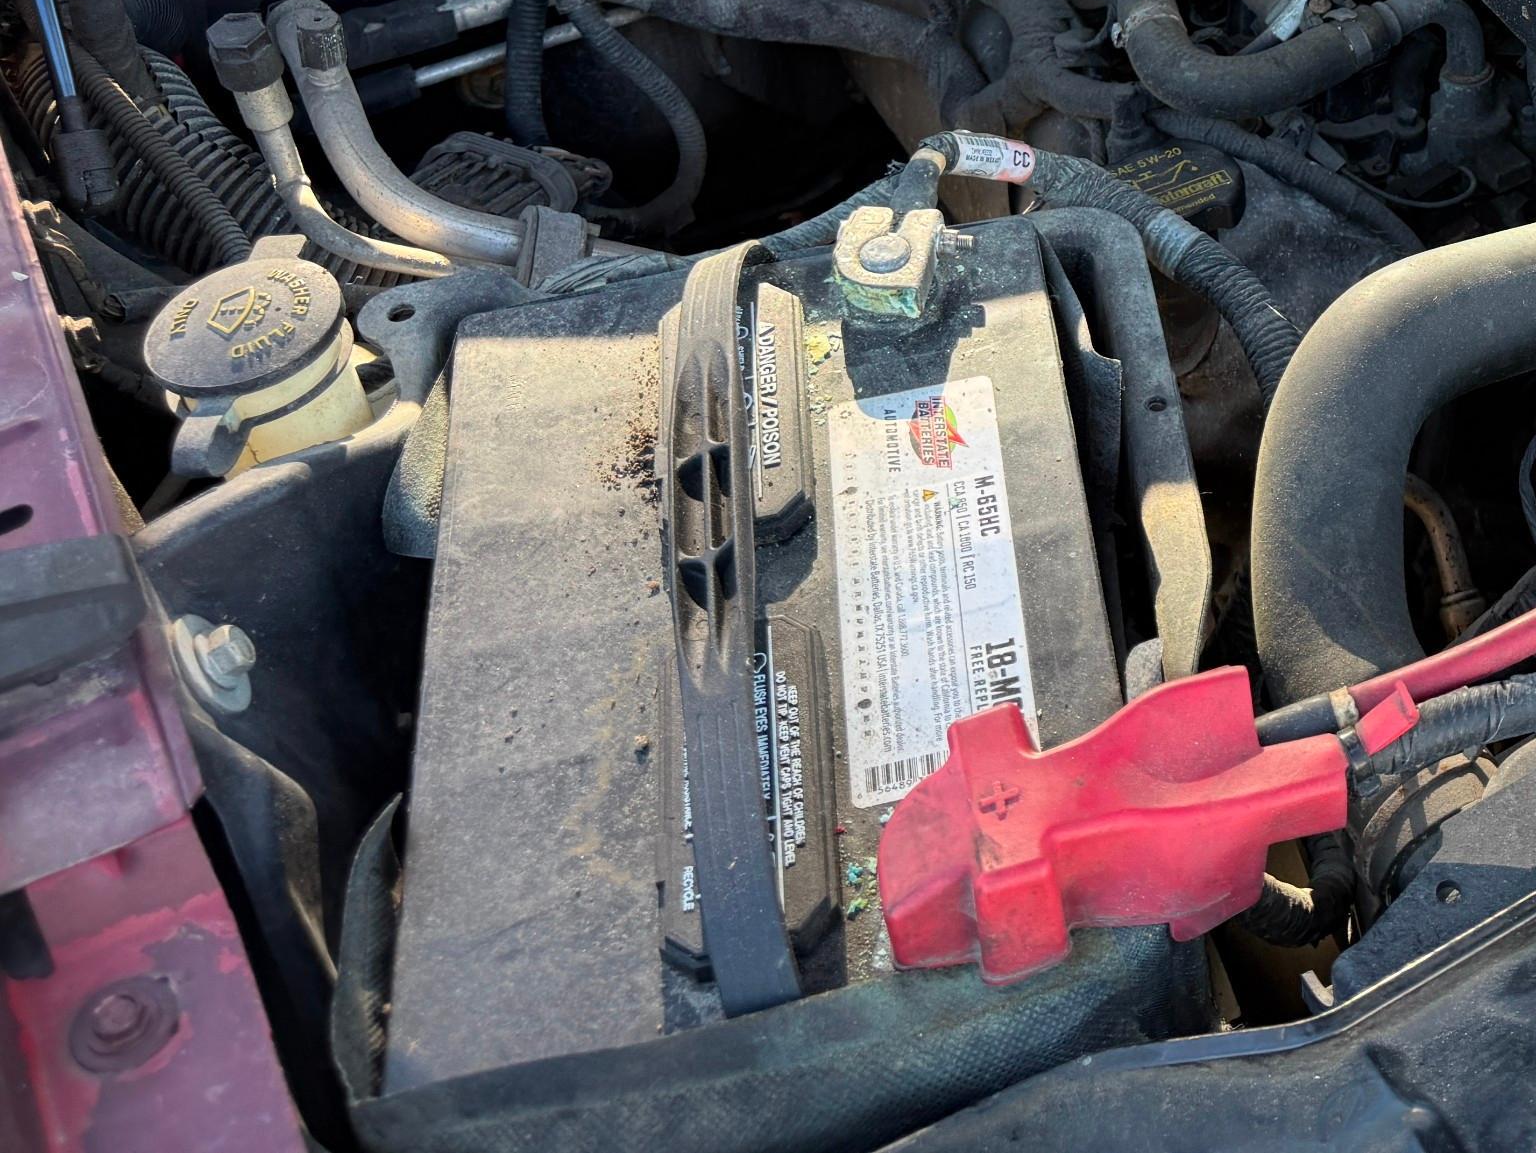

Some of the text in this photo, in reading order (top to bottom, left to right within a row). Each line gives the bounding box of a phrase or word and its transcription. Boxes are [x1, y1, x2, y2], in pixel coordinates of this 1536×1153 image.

[1013, 150, 1031, 168] CC
[1137, 147, 1182, 168] 5W-20
[1154, 172, 1225, 204] otorcraft
[231, 269, 311, 359] WASHER FLUID
[883, 407, 901, 474] AUTOMOTIVE
[917, 400, 935, 465] BATTERIES
[930, 395, 950, 469] INTERSTATE
[951, 479, 966, 497] CCA
[956, 519, 970, 532] CA
[961, 559, 975, 573] RC
[962, 572, 977, 590] 150
[874, 623, 884, 632] TX
[874, 631, 886, 653] 75251
[876, 653, 887, 669] USA
[774, 670, 786, 683] DO
[969, 644, 989, 711] FREE REPL
[753, 673, 767, 705] FLUSH
[775, 683, 787, 702] NOT
[754, 706, 768, 733] EYES
[777, 719, 789, 742] KEEP
[778, 742, 790, 765] VENT
[786, 685, 806, 845] KEEP OUT OF THE REACH OF CHILDREN
[779, 764, 792, 791] CAPS
[780, 790, 793, 817] TIGHT
[781, 816, 794, 838] AND
[782, 837, 796, 868] LEVEL
[683, 865, 696, 912] RECYCLE
